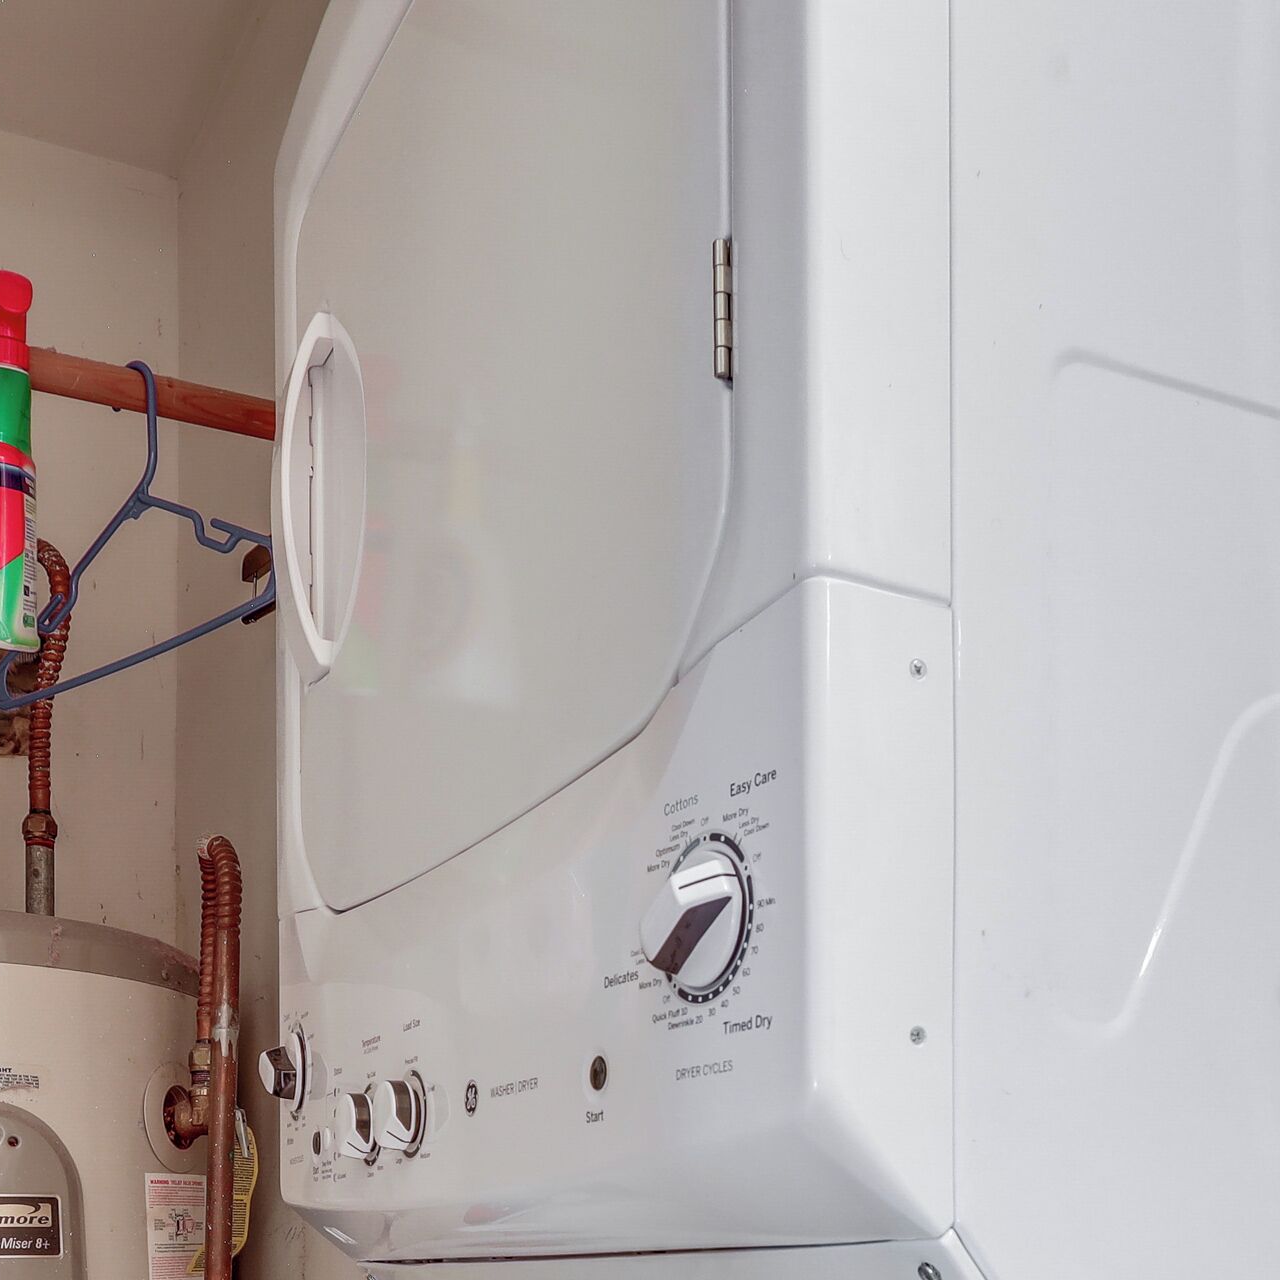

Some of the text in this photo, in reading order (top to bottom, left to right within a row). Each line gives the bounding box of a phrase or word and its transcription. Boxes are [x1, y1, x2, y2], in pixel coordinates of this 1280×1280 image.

[730, 769, 777, 798] Easy Care
[663, 794, 699, 816] Cottons
[722, 808, 749, 823] More Dry
[661, 859, 671, 870] Dry
[604, 969, 639, 989] Delicates
[652, 1011, 667, 1024] Quick
[723, 1014, 773, 1035] Timed Dry
[675, 1060, 733, 1081] DRYER CYCLES
[490, 1077, 539, 1098] WASHER DRYER
[586, 1109, 604, 1124] Start
[1, 1237, 33, 1249] Miser
[35, 1237, 51, 1249] 8+
